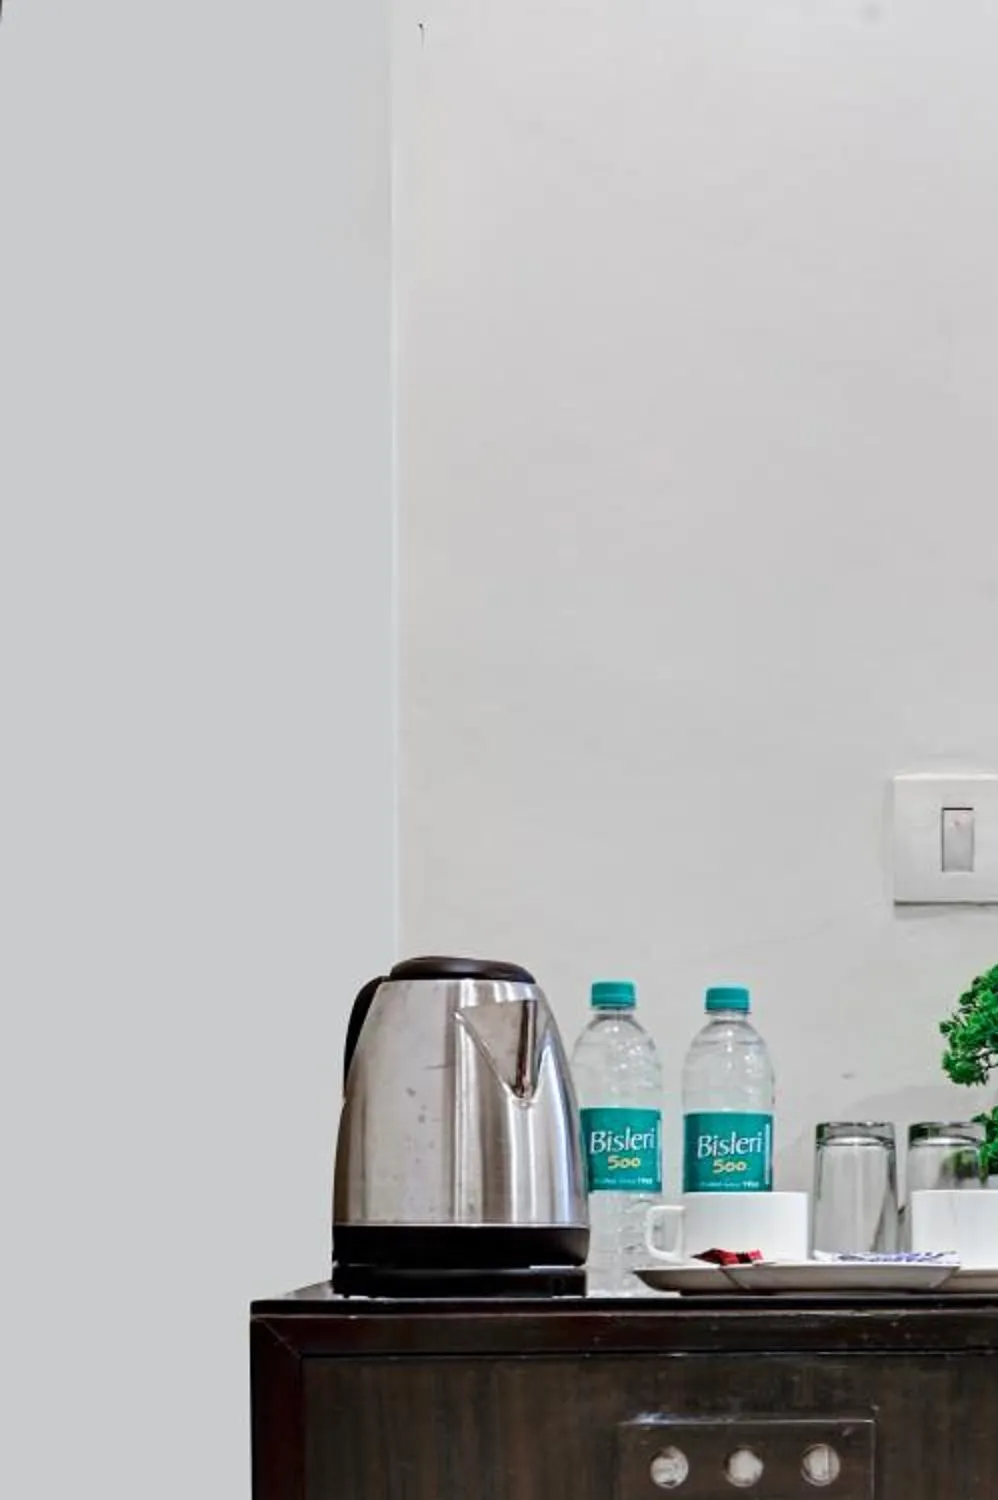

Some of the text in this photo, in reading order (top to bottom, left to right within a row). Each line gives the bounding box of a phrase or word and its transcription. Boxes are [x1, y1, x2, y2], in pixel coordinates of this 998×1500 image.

[590, 1126, 655, 1154] Bisleri
[697, 1131, 762, 1159] Bisleri
[607, 1155, 641, 1171] 500
[713, 1159, 748, 1174] 500
